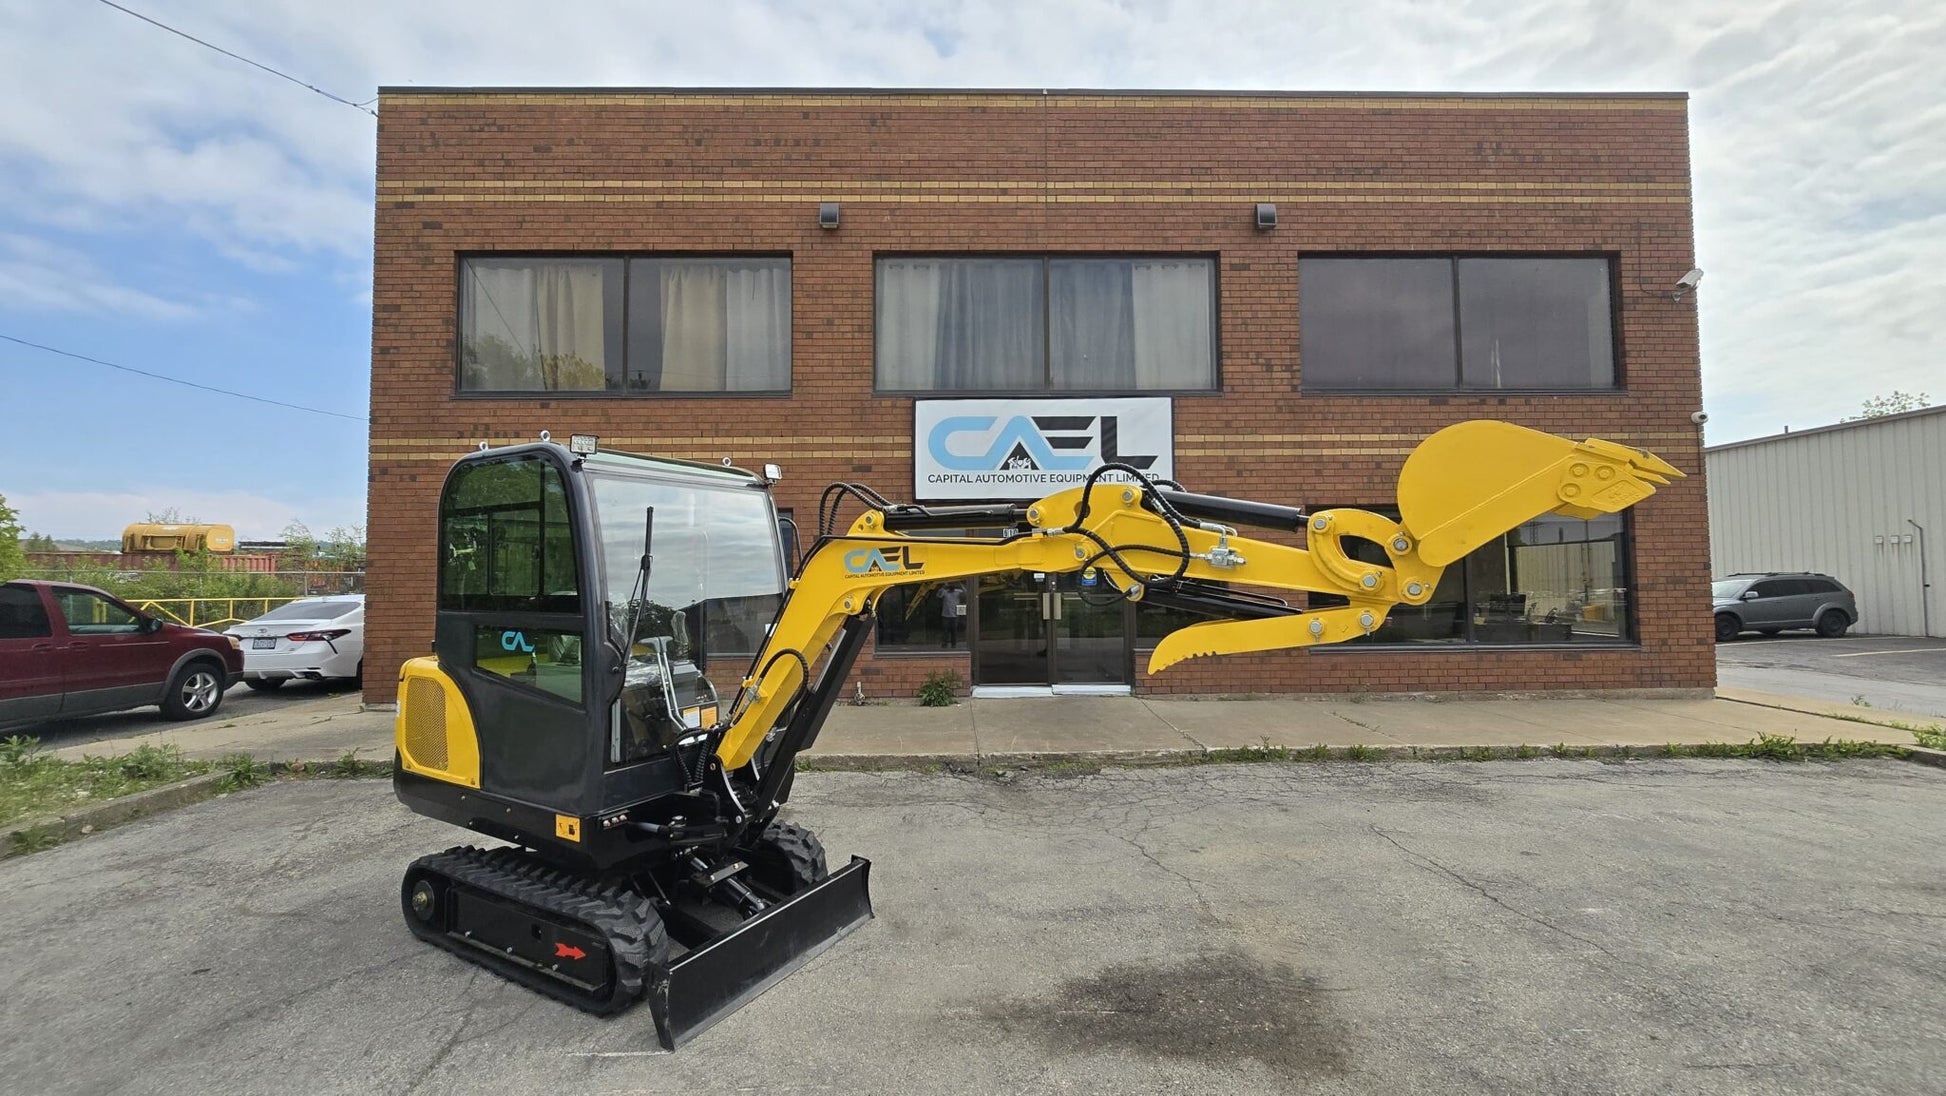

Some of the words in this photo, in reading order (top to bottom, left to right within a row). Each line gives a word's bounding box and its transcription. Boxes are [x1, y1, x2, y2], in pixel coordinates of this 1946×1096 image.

[928, 415, 1158, 471] CAEL
[928, 474, 973, 483] CAPITAL
[975, 474, 1046, 483] AUTOMOTIVE
[1049, 473, 1115, 483] EQUIPMNT
[844, 546, 924, 573] CAEL
